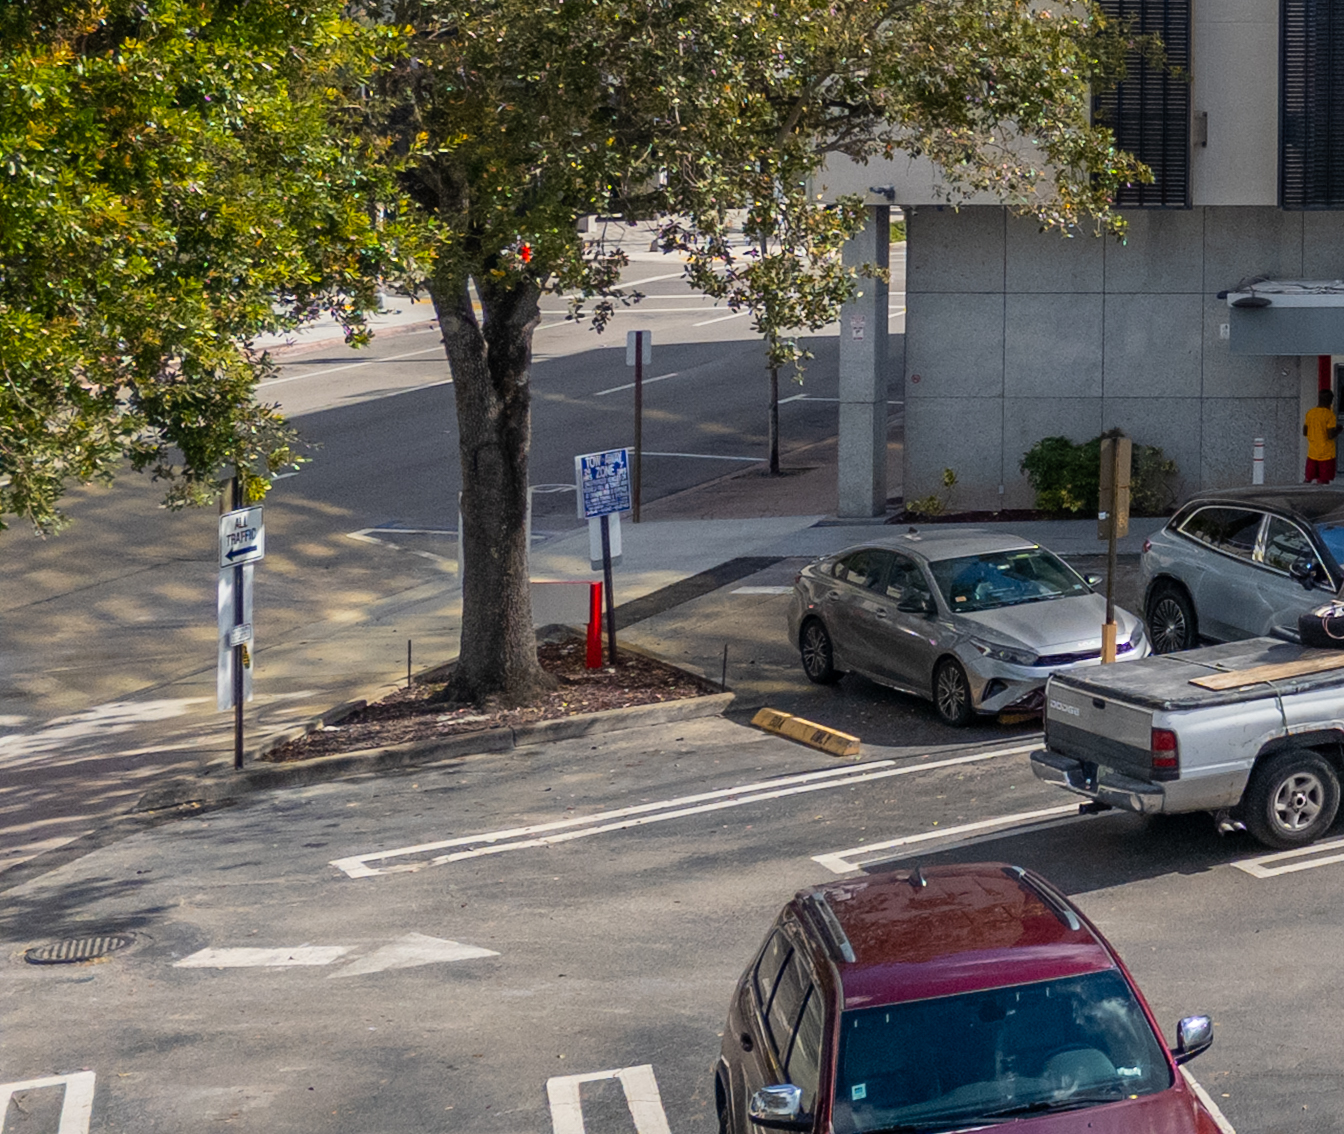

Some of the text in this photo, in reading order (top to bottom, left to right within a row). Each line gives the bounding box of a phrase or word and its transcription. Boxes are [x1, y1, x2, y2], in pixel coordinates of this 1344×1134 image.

[595, 464, 615, 479] ZONE
[234, 516, 248, 531] ALL
[226, 527, 256, 547] TRAFFIC
[1050, 699, 1080, 716] DODGE
